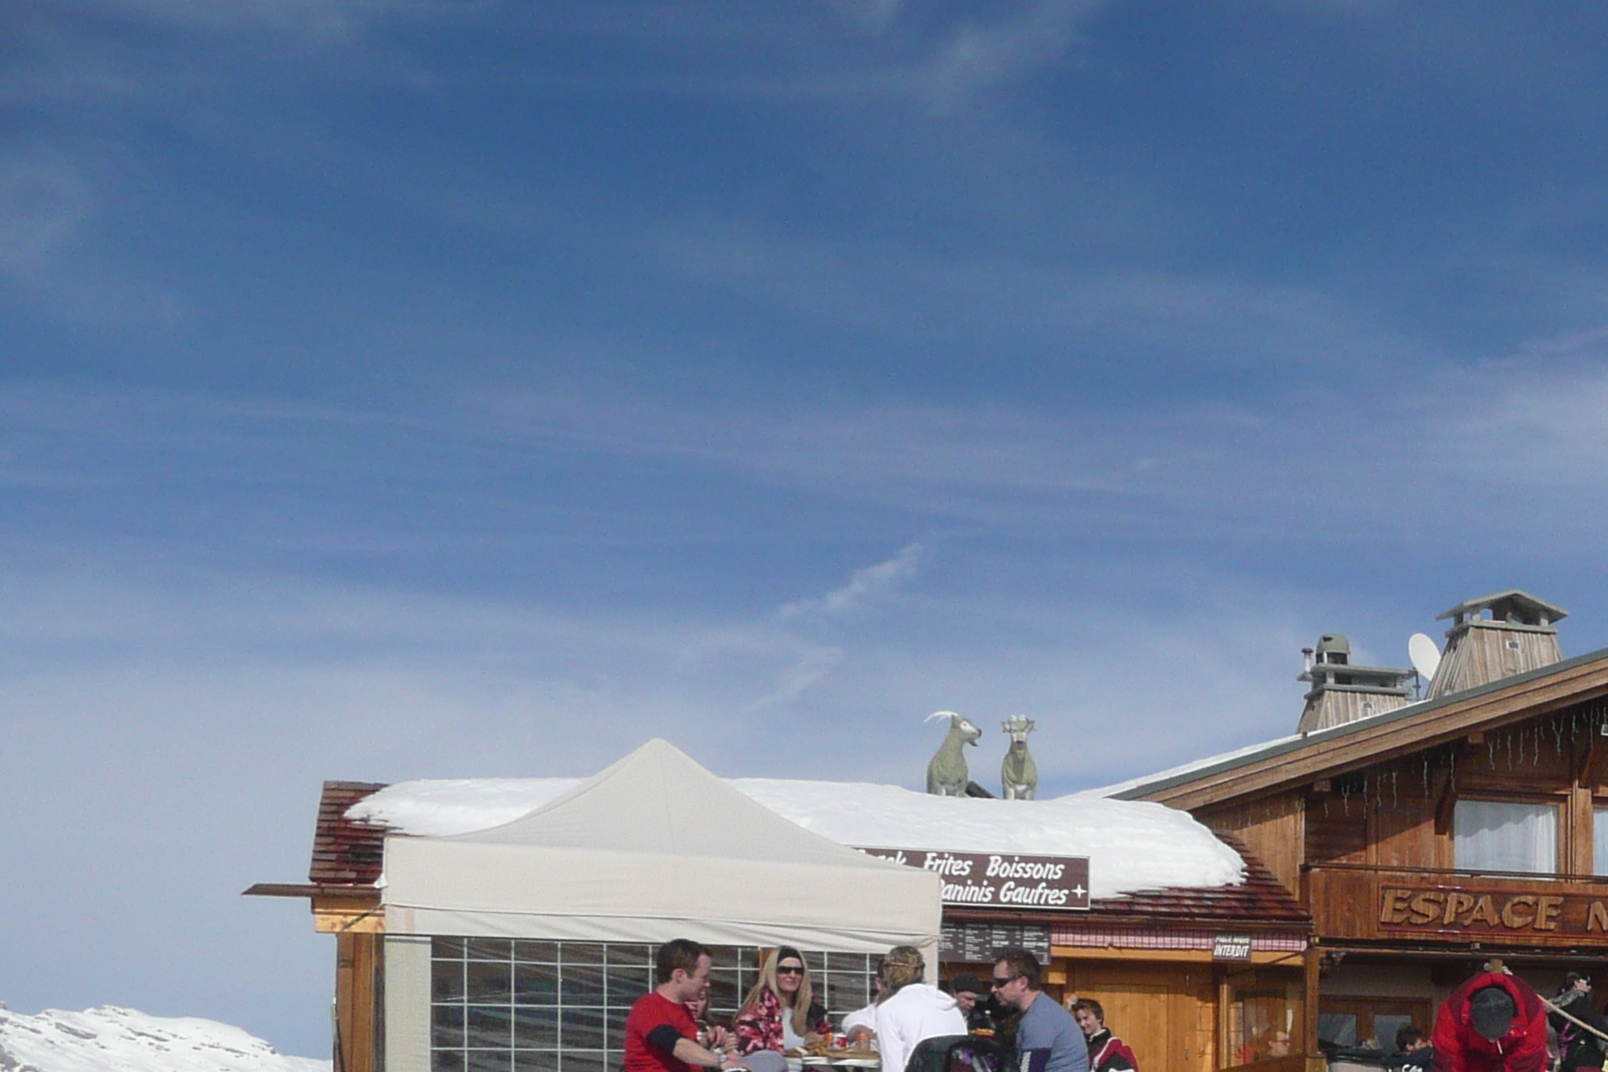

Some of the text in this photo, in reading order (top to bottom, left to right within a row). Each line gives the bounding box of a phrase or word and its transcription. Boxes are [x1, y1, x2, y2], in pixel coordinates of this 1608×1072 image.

[923, 852, 974, 877] Frites
[986, 855, 1065, 880] Boissons
[999, 880, 1069, 905] Gaufres
[1380, 889, 1565, 931] ESPACE
[1213, 944, 1250, 958] INTERDIT
